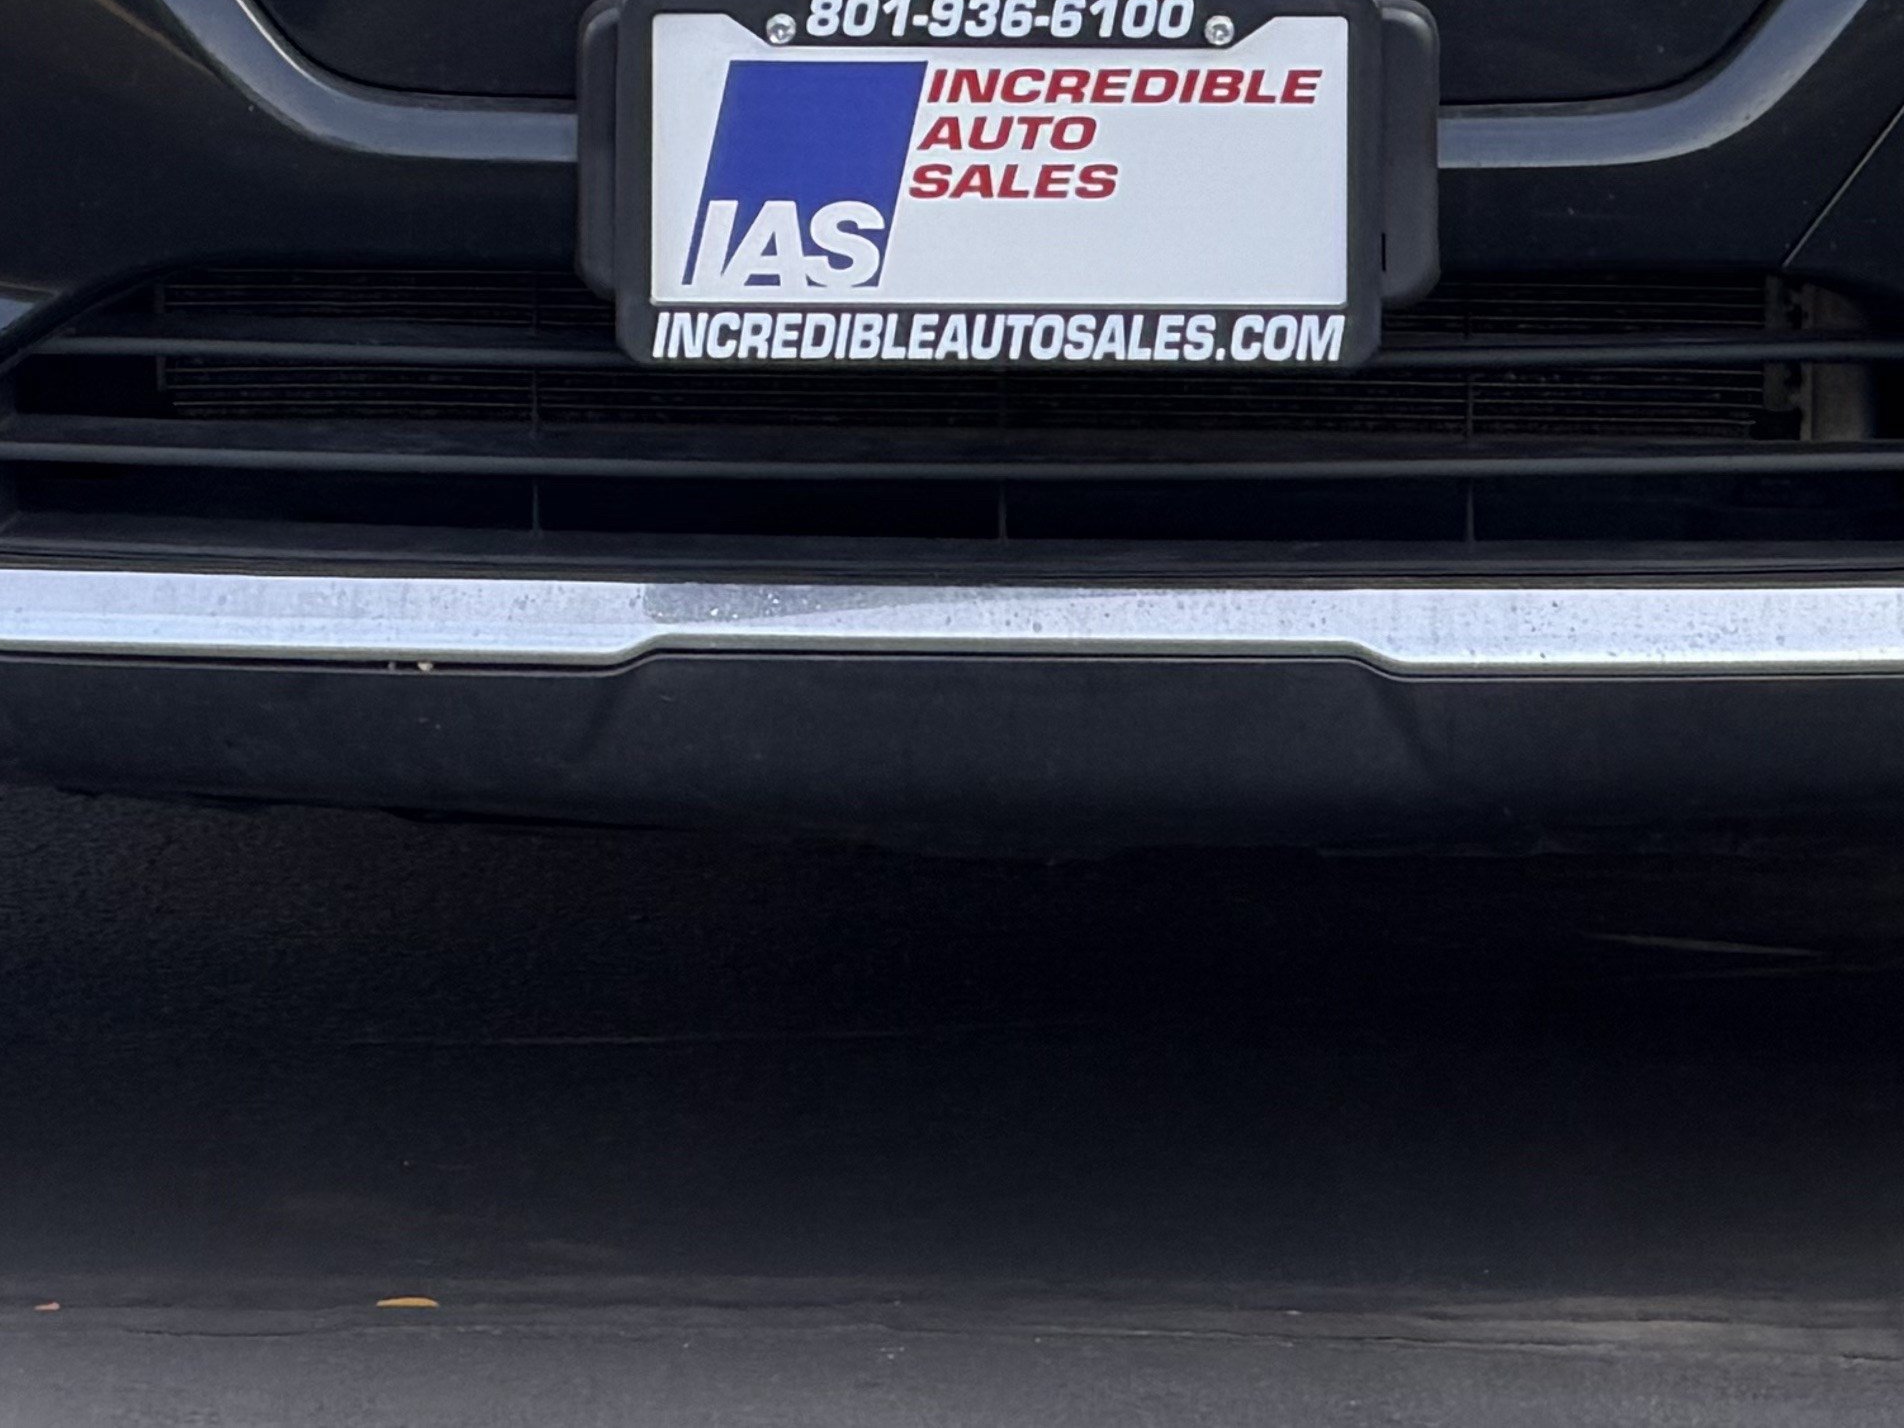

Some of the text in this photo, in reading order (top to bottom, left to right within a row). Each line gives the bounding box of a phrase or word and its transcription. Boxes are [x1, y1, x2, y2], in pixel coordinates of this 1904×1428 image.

[927, 68, 1322, 104] INCREDIBLE
[917, 115, 1097, 151] AUTO
[908, 163, 1119, 200] SALES
[694, 199, 886, 288] IAS
[651, 310, 1347, 362] INCREDIBLEAUTOSALES.COM
